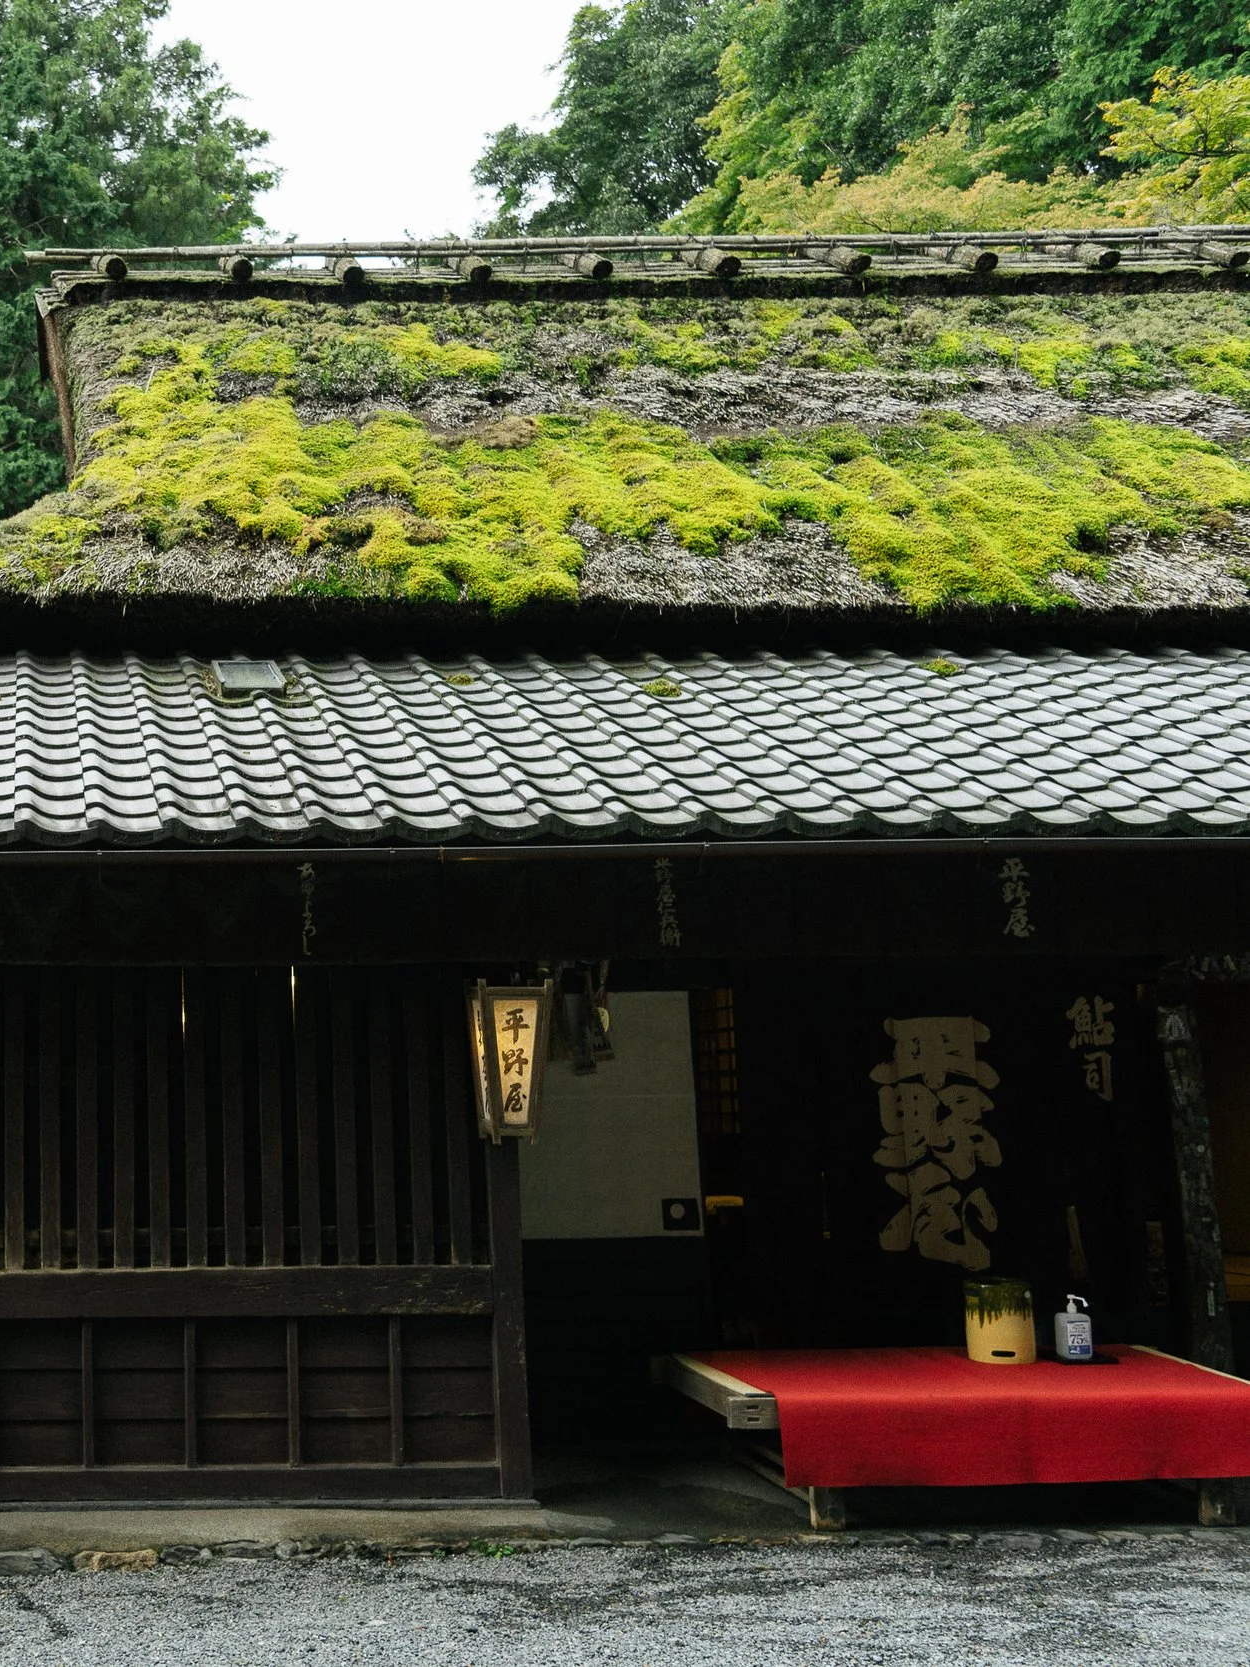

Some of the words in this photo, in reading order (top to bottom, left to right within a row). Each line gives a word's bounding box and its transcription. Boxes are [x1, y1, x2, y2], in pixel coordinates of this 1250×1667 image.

[998, 857, 1035, 938] 平野屋
[501, 1008, 530, 1113] 平野屋
[1065, 995, 1115, 1101] 鮎司
[869, 1015, 1003, 1272] 平野屋
